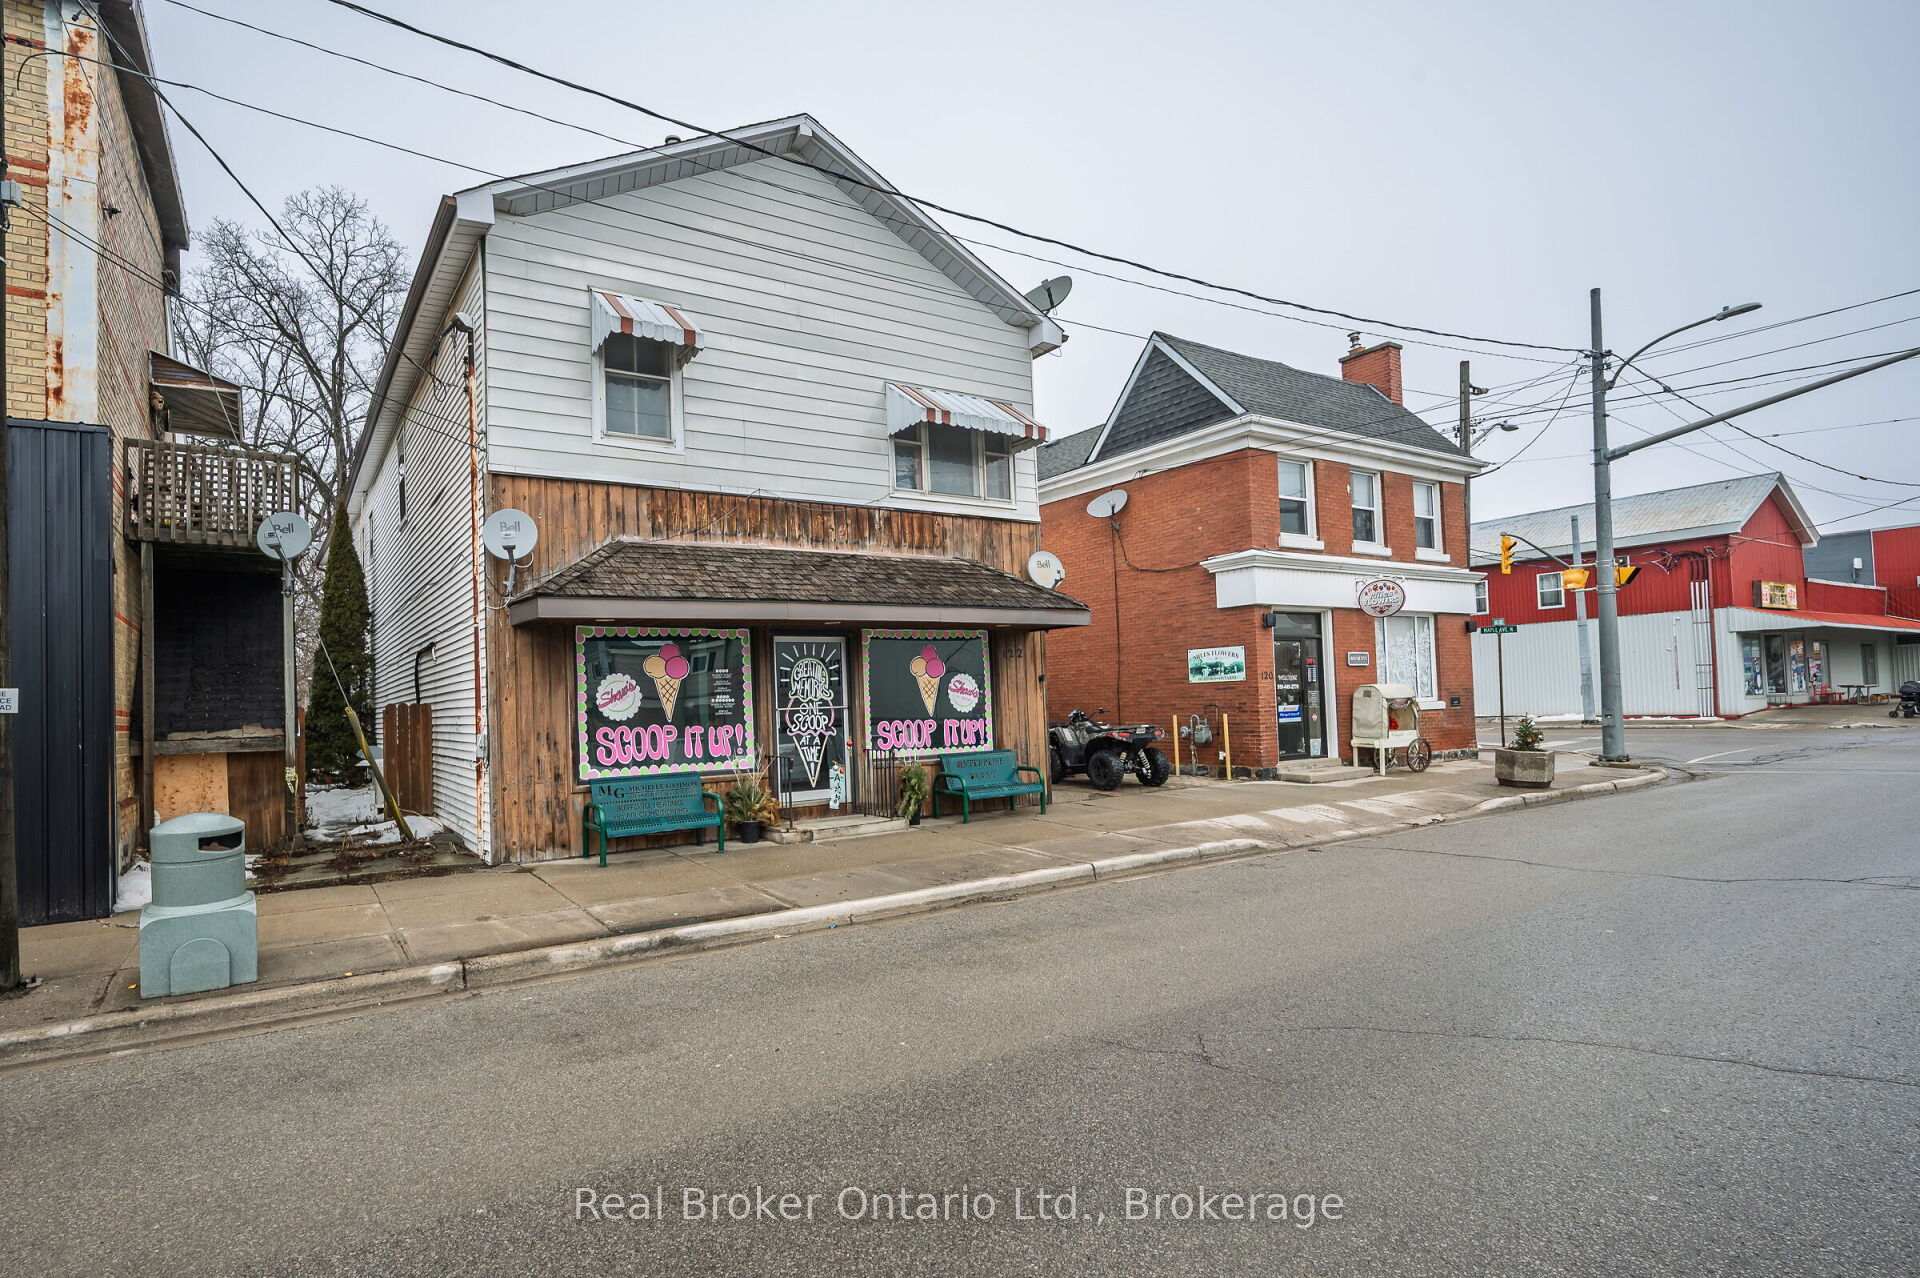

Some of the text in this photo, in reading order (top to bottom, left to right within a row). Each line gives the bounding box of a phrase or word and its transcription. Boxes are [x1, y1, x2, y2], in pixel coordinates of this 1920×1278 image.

[273, 522, 294, 534] Bell
[793, 660, 826, 681] CREATING
[1261, 671, 1274, 680] 120
[799, 701, 823, 715] ONE
[791, 713, 829, 732] SCOOP
[799, 735, 821, 746] AT A
[877, 718, 985, 750] SCOOP IT UP!
[596, 723, 744, 766] SCOOP IT UP!
[599, 785, 625, 799] MG
